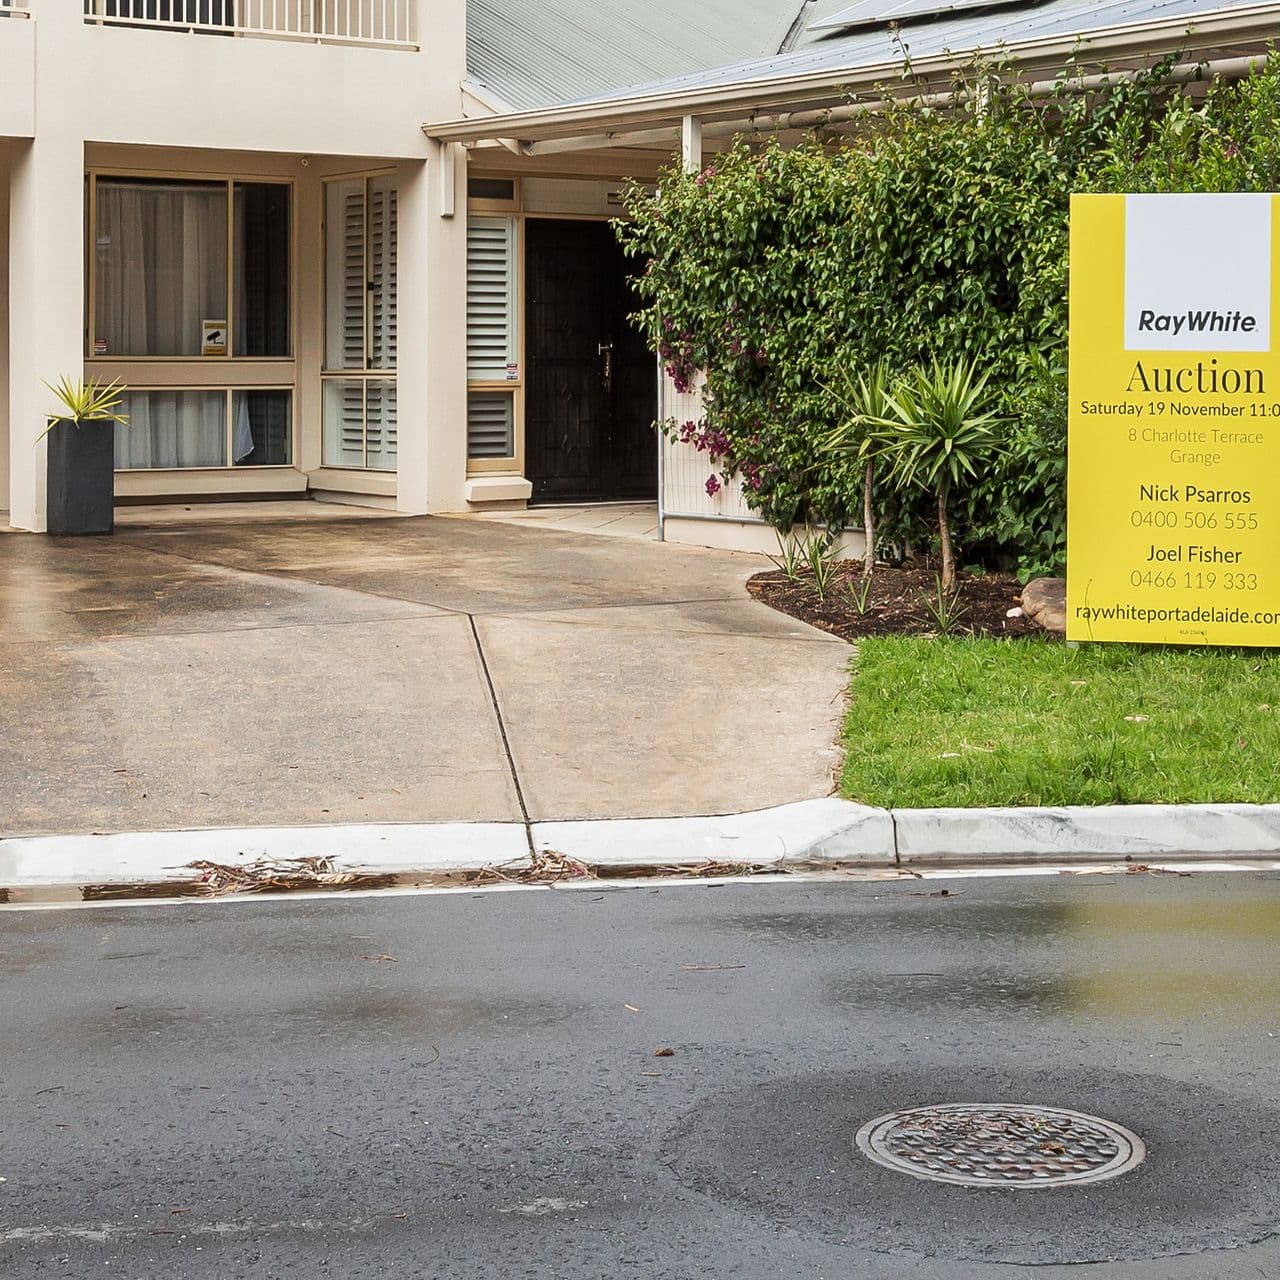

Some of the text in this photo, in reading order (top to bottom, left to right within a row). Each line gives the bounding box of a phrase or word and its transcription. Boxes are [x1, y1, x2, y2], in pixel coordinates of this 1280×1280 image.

[1125, 359, 1266, 394] Auction
[1081, 401, 1143, 416] Saturday
[1148, 402, 1165, 415] 19
[1170, 403, 1245, 417] November
[1128, 428, 1264, 444] 8 Charlotte Terrace
[1170, 449, 1221, 466] Grange
[1140, 485, 1251, 503] Nick Psarros
[1131, 510, 1258, 530] 0400 506 555
[1147, 545, 1242, 563] Joel Fisher
[1130, 570, 1258, 590] 0466 119 333
